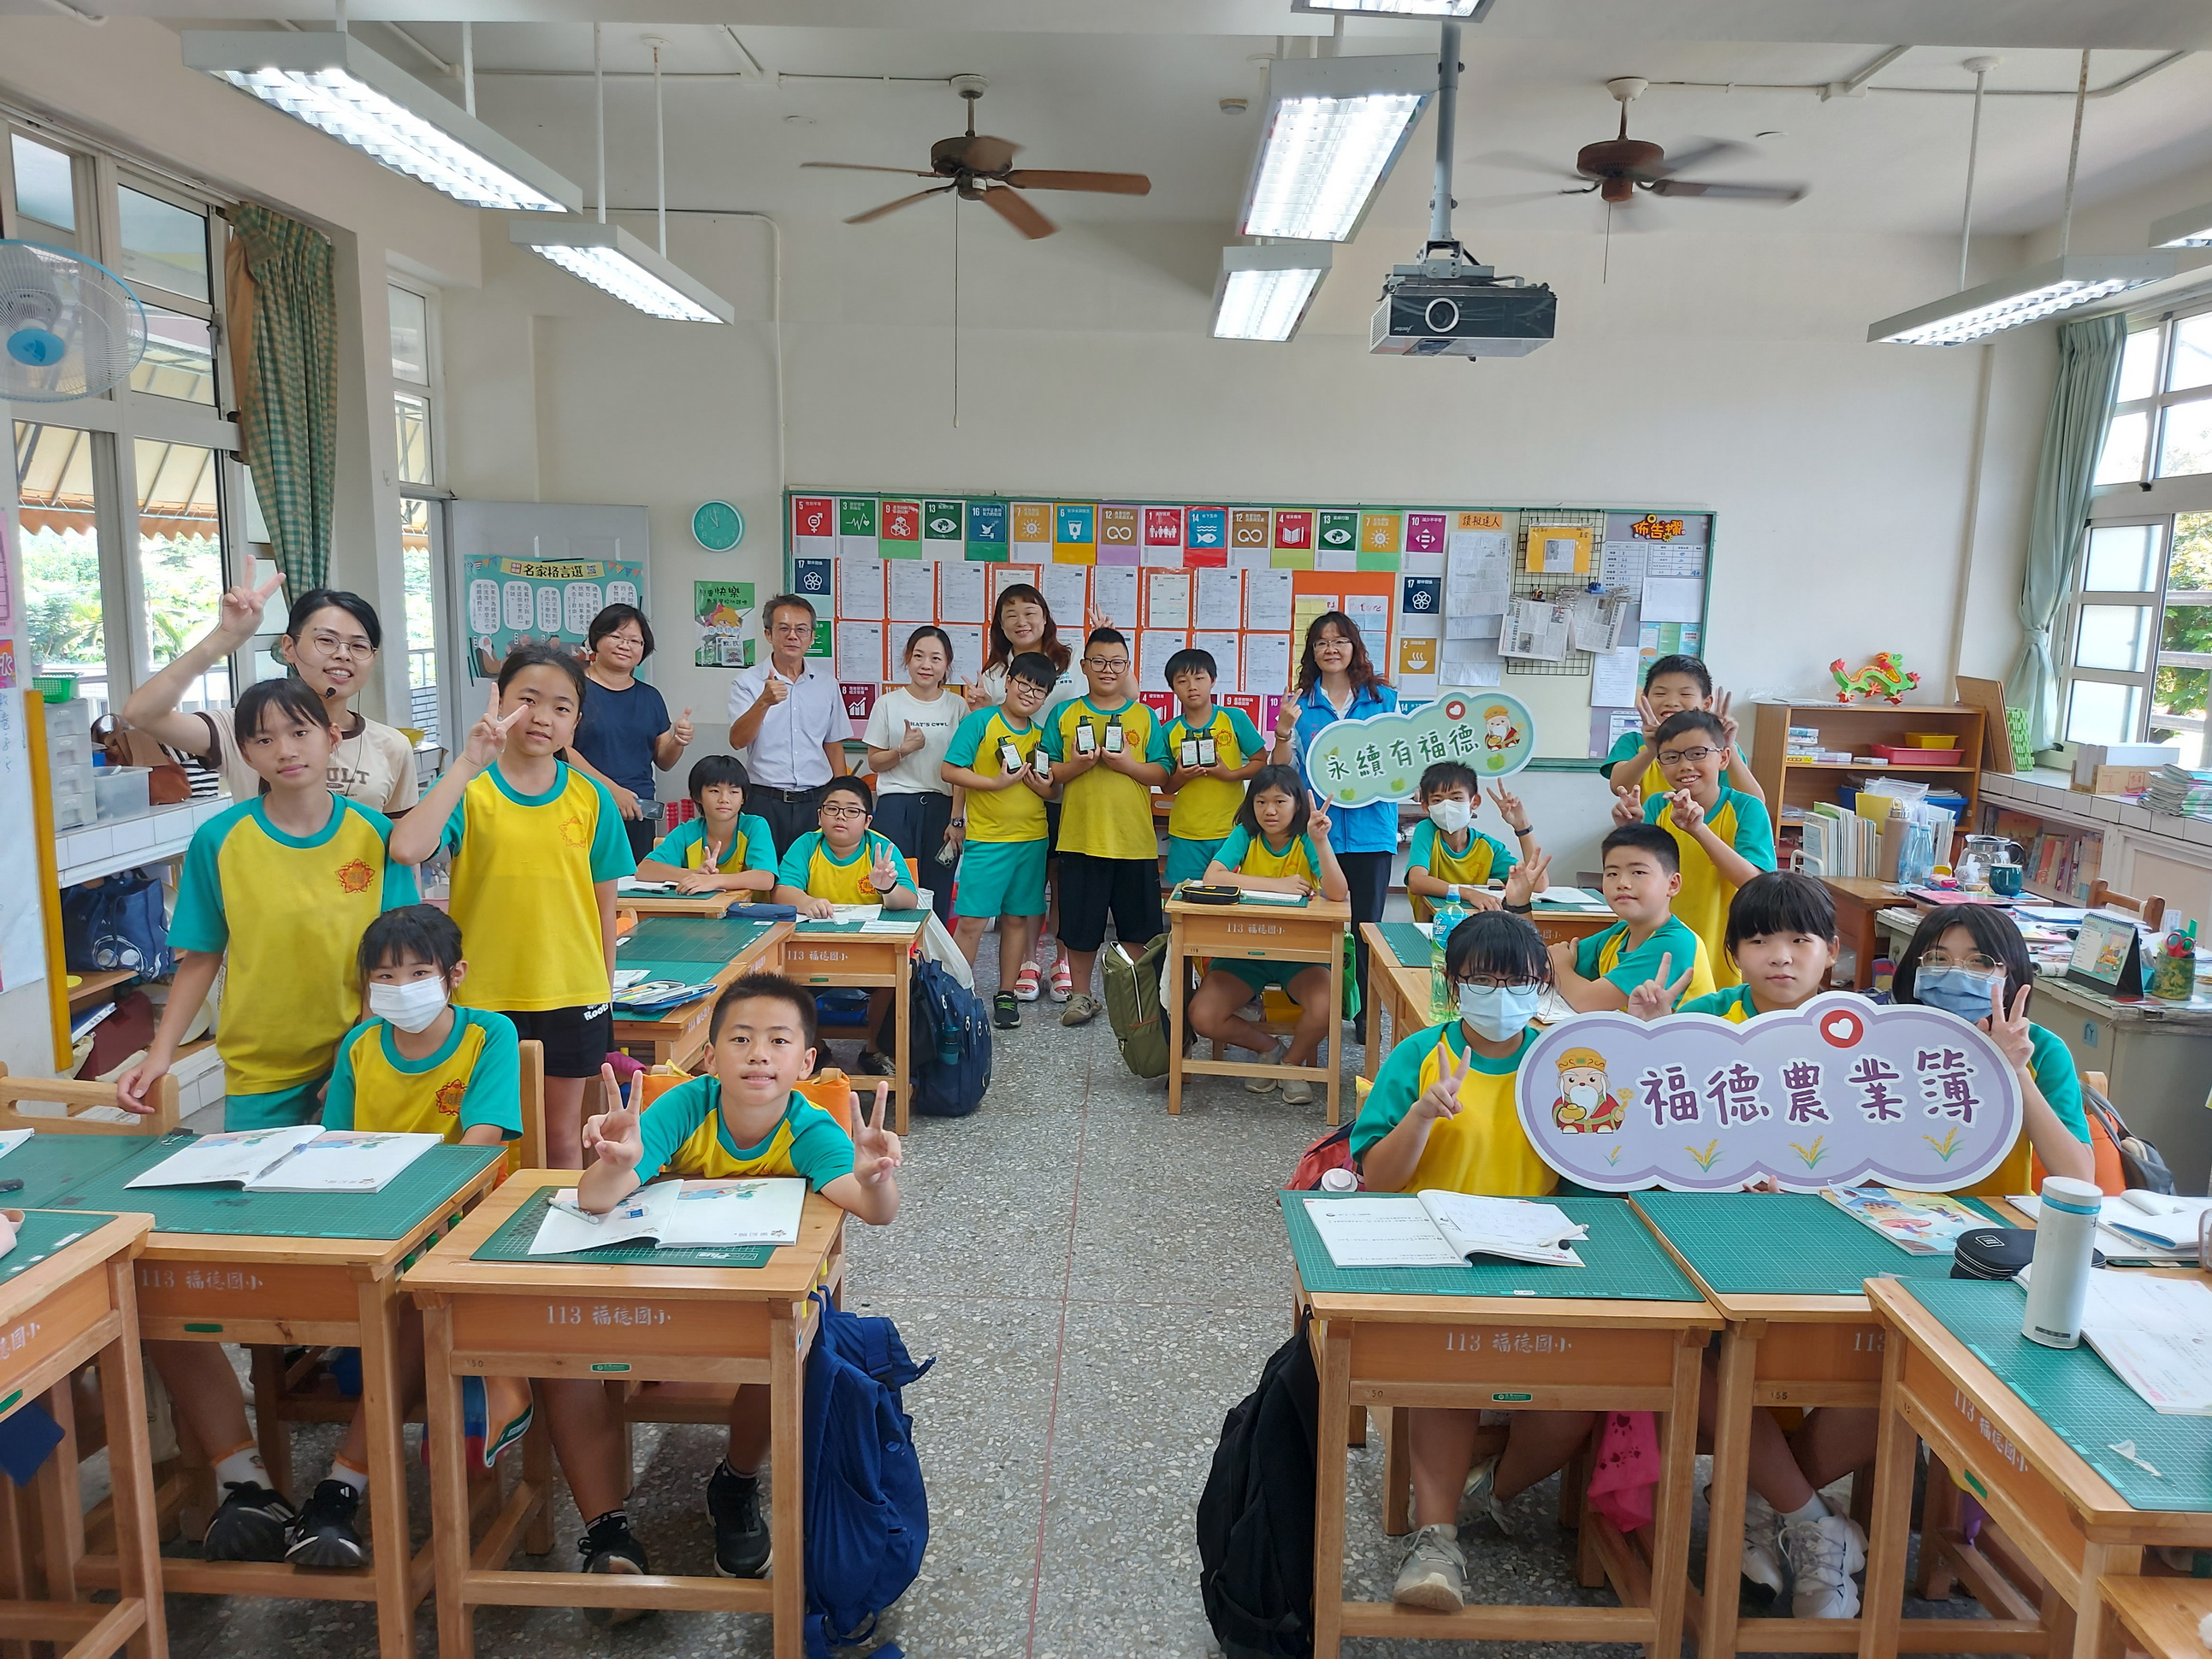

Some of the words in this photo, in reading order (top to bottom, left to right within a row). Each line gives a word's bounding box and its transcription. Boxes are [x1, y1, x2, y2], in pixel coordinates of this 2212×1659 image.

[799, 501, 803, 510] 5
[843, 501, 847, 511] 3
[885, 505, 890, 513] 9
[928, 504, 936, 513] 13
[973, 507, 980, 516] 16
[1060, 509, 1065, 517] 6
[1105, 511, 1112, 519] 12
[1149, 511, 1152, 520] 1
[1192, 513, 1199, 522] 14
[1236, 514, 1243, 522] 12
[1323, 515, 1331, 523] 13
[1411, 517, 1419, 526] 10
[1633, 520, 1683, 539] 佈告欄
[523, 564, 583, 578] 名家格言選
[1407, 579, 1415, 588] 17
[1403, 641, 1408, 649] 2
[842, 686, 847, 694] 8
[1142, 694, 1147, 702] 4
[1227, 696, 1232, 706] 9
[1270, 698, 1278, 706] 10
[1328, 724, 1480, 780] 永續有福德
[1226, 923, 1244, 934] 113
[787, 950, 805, 960] 113
[809, 951, 848, 961] 福德國小
[1639, 1048, 1979, 1125] 福德農業簿
[142, 1269, 175, 1288] 113
[185, 1270, 263, 1291] 福德國小
[547, 1305, 582, 1325] 113
[592, 1305, 671, 1325] 福德國小
[1446, 1331, 1481, 1352] 113
[1492, 1332, 1571, 1354] 福德國小
[1954, 1387, 1974, 1423] 113
